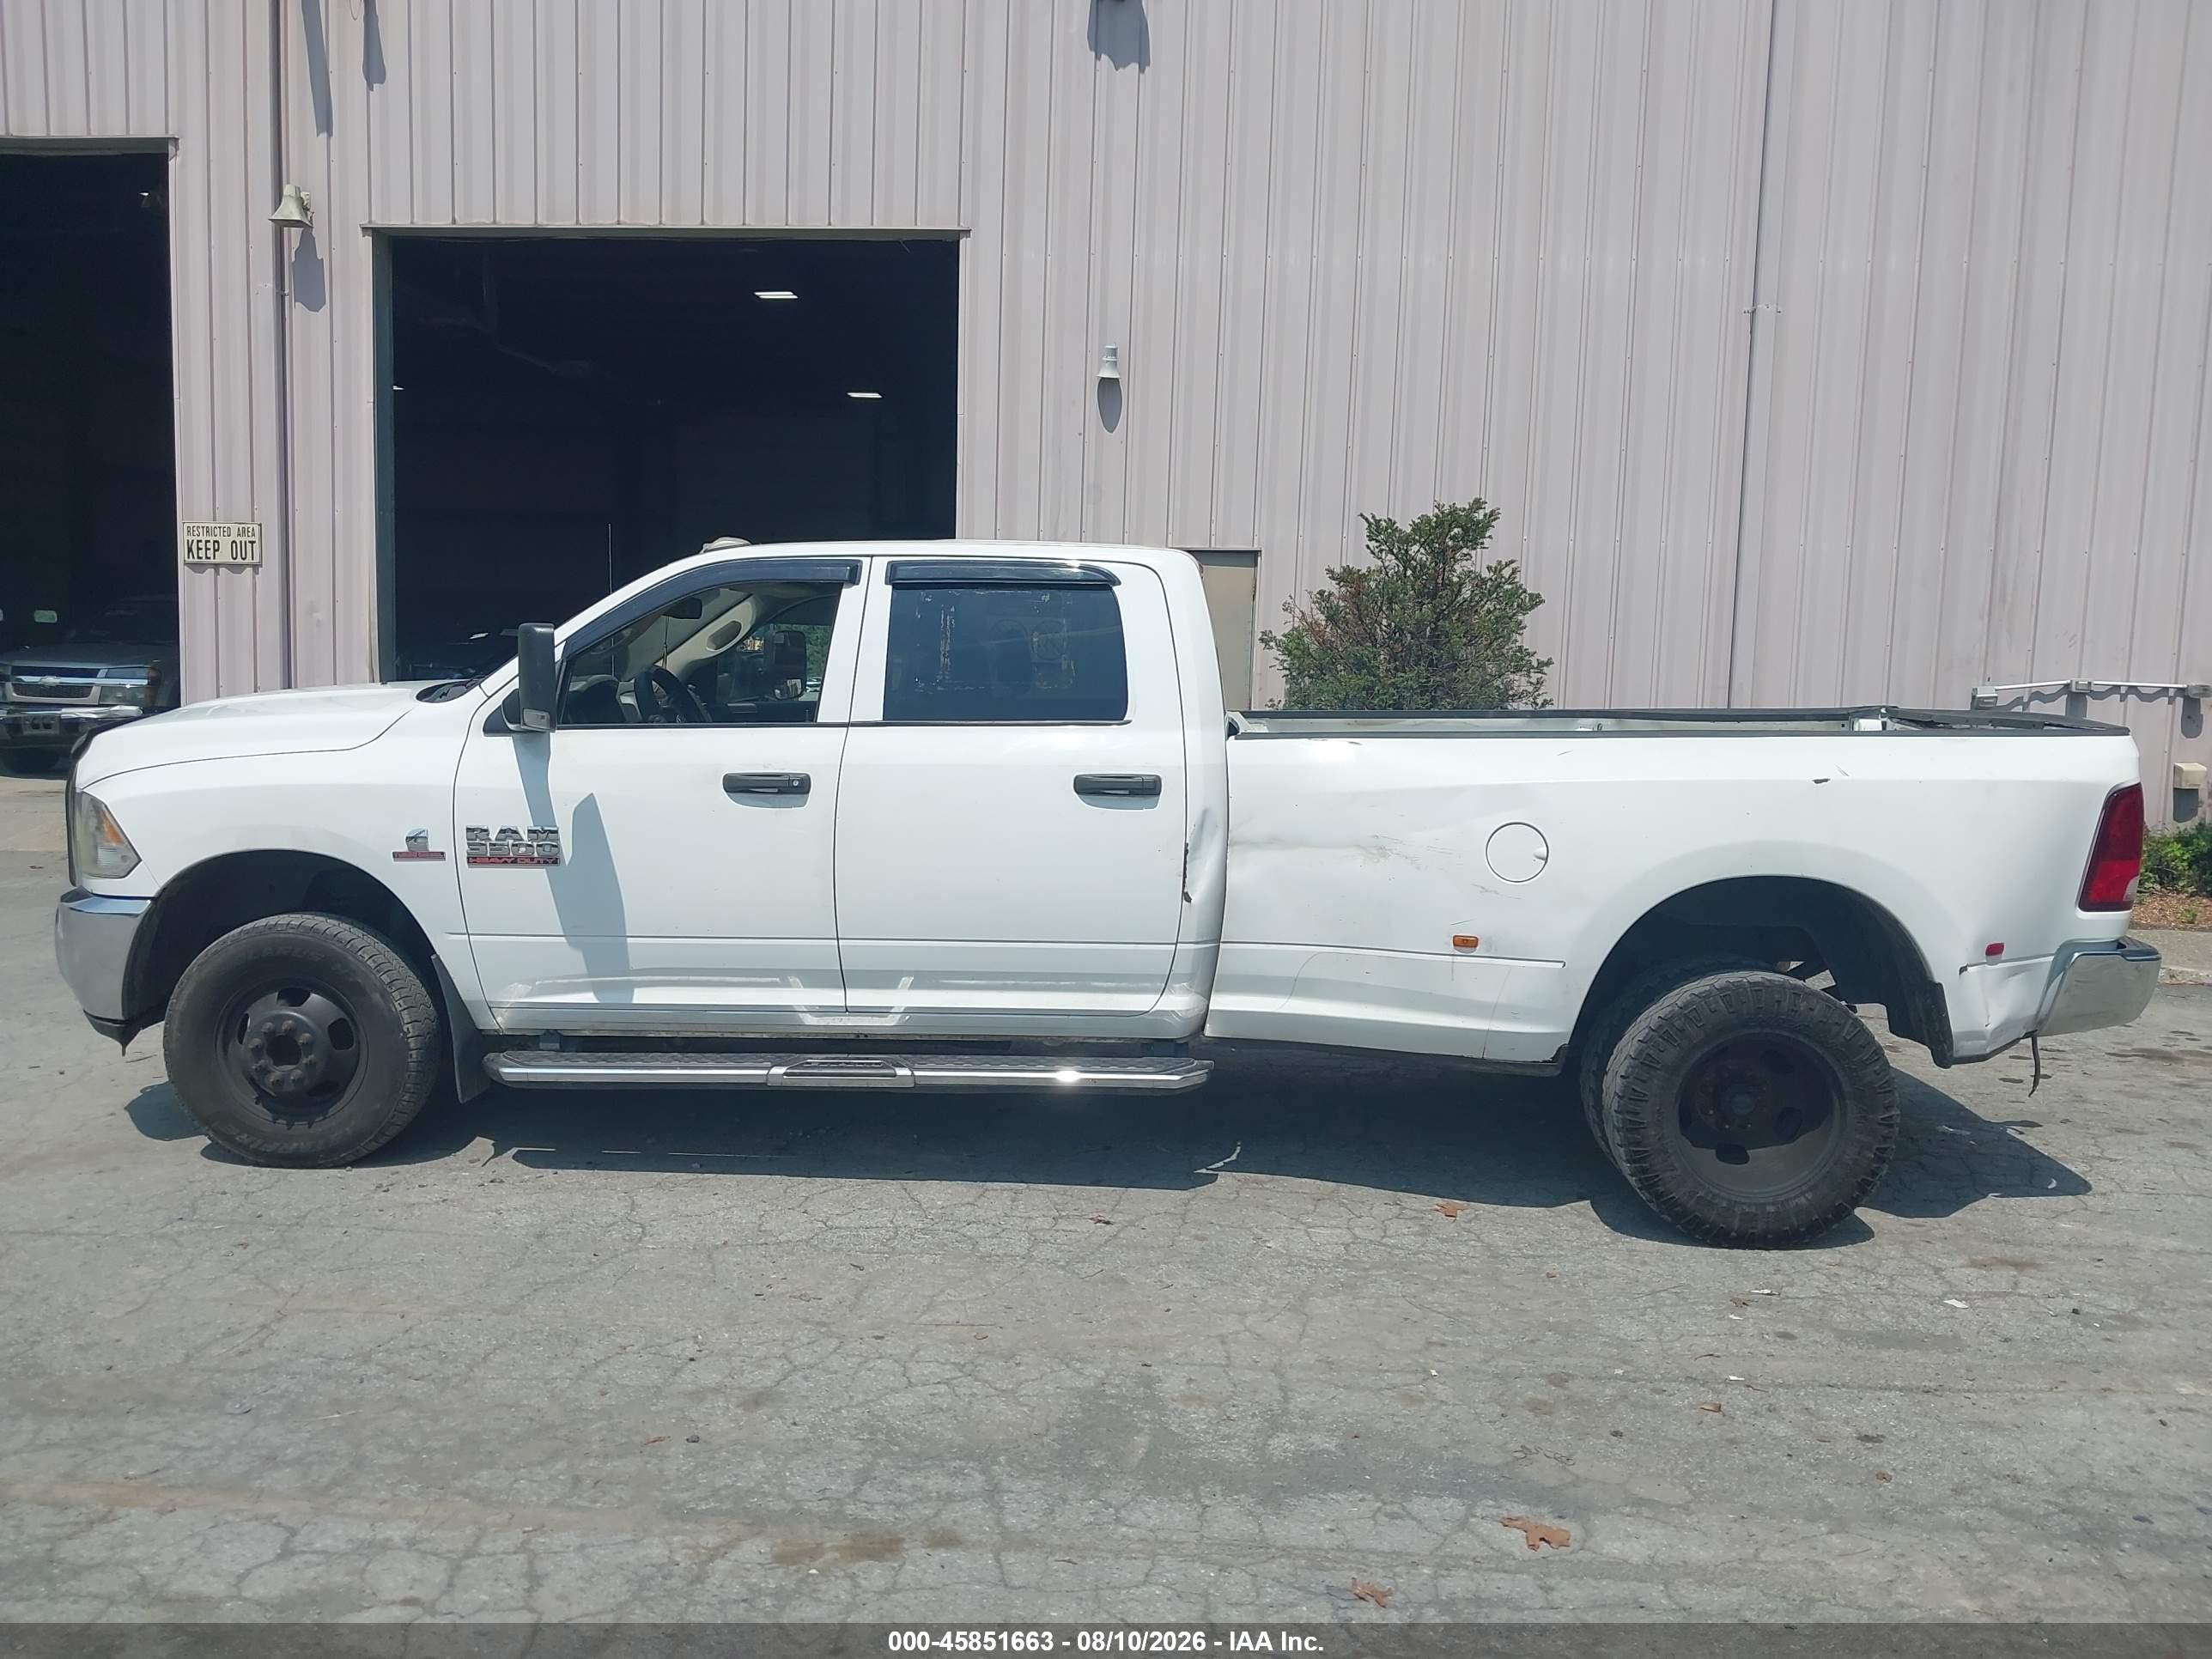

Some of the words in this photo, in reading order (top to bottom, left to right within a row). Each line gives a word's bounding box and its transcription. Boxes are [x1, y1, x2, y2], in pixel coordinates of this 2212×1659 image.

[186, 526, 231, 538] RESTRICTED
[237, 526, 256, 538] AREA
[186, 539, 220, 560] KEEP
[230, 540, 256, 561] OUT
[466, 825, 559, 842] RAM
